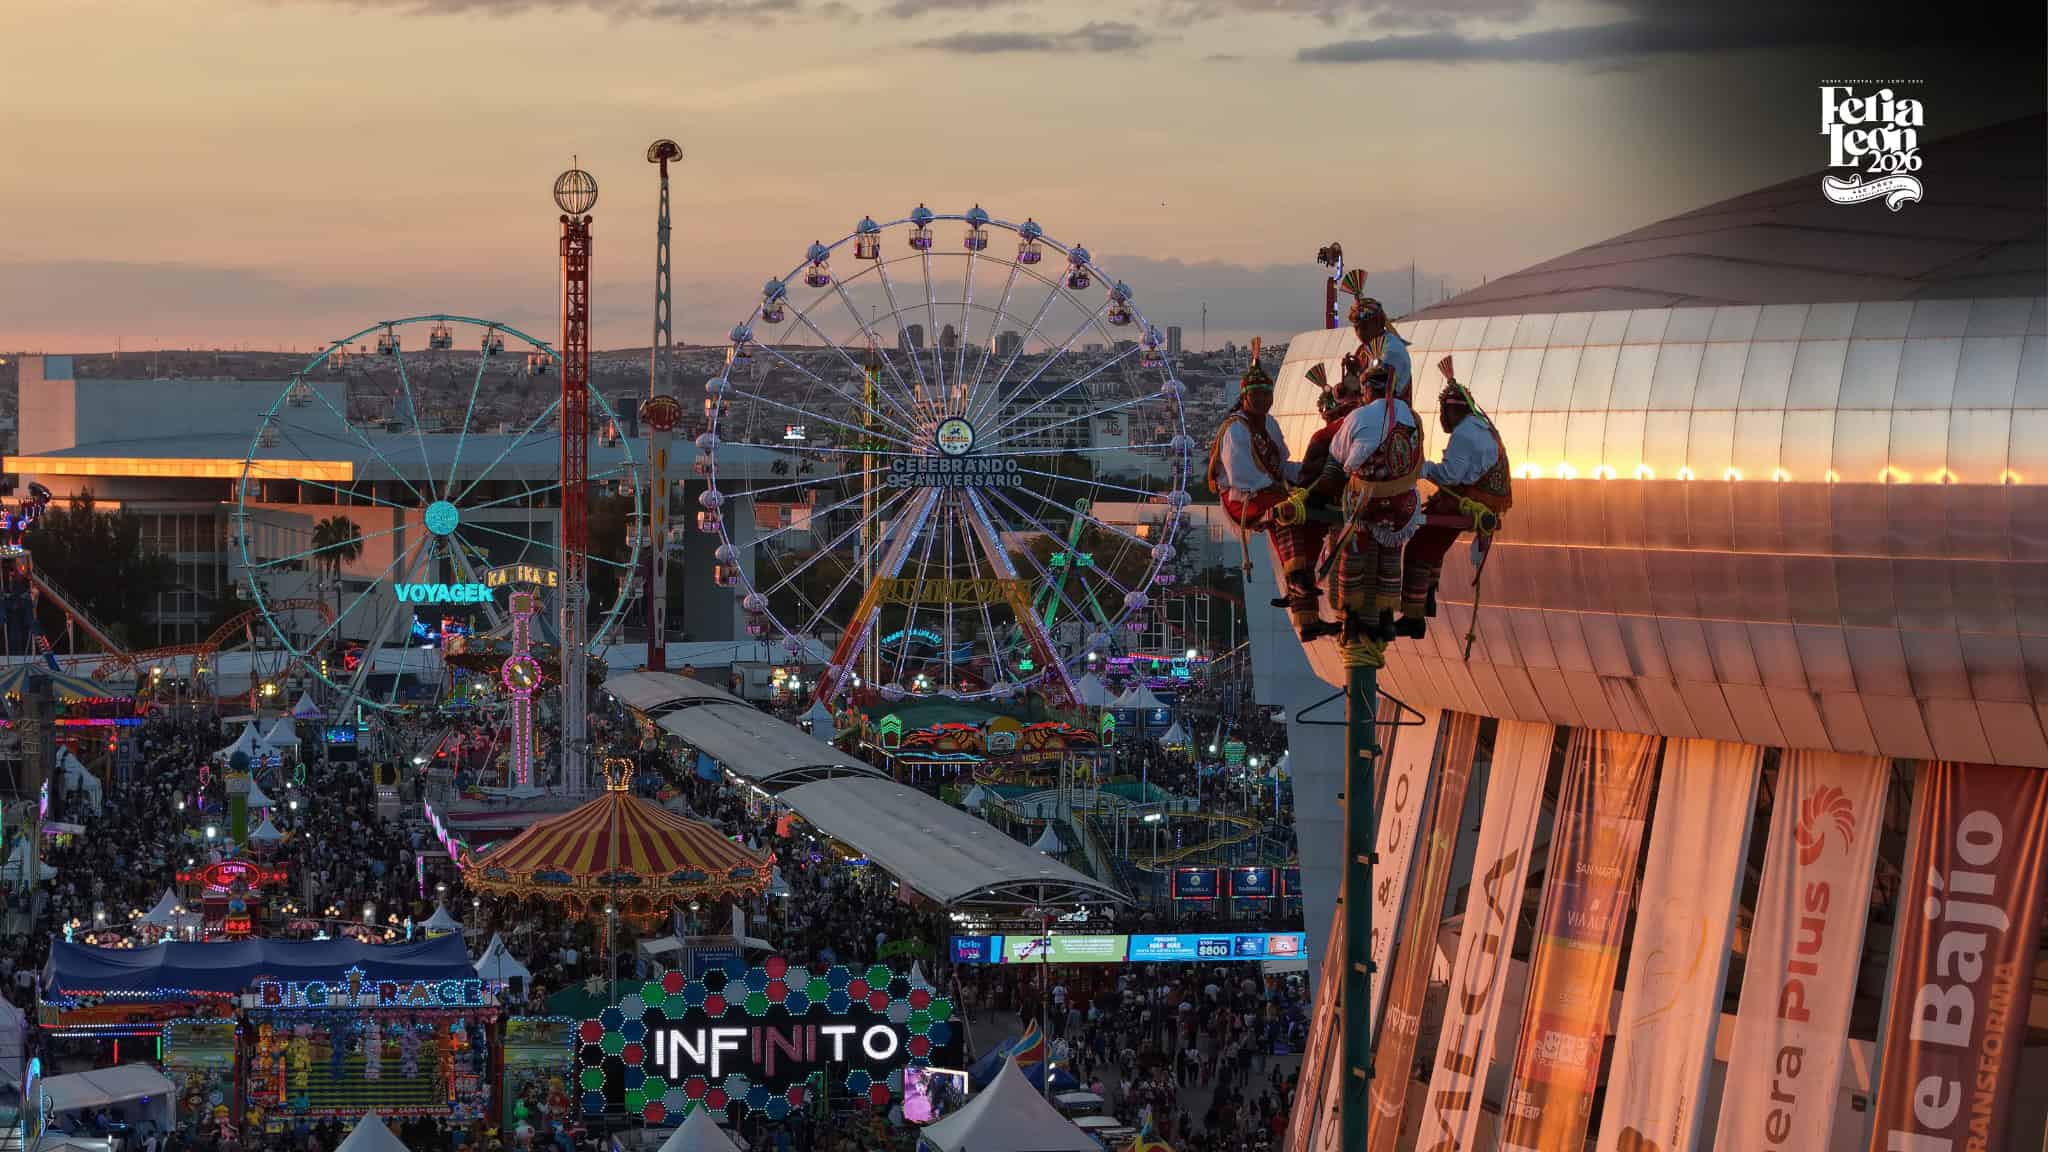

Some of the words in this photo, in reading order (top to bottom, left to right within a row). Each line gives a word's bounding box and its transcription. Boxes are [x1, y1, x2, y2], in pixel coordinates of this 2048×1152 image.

[887, 473, 913, 488] 95
[914, 474, 1023, 487] ANIVERSARIO
[892, 458, 1018, 473] CELEBRANDO
[1199, 945, 1228, 956] $800
[1777, 881, 1830, 1022] Plus
[1910, 810, 2010, 1047] Bajío
[260, 980, 329, 1009] BIG
[376, 978, 485, 1008] RACE
[655, 1024, 899, 1080] INFINITO
[1966, 962, 2018, 1152] RANSFORMA
[1765, 1045, 1803, 1152] era
